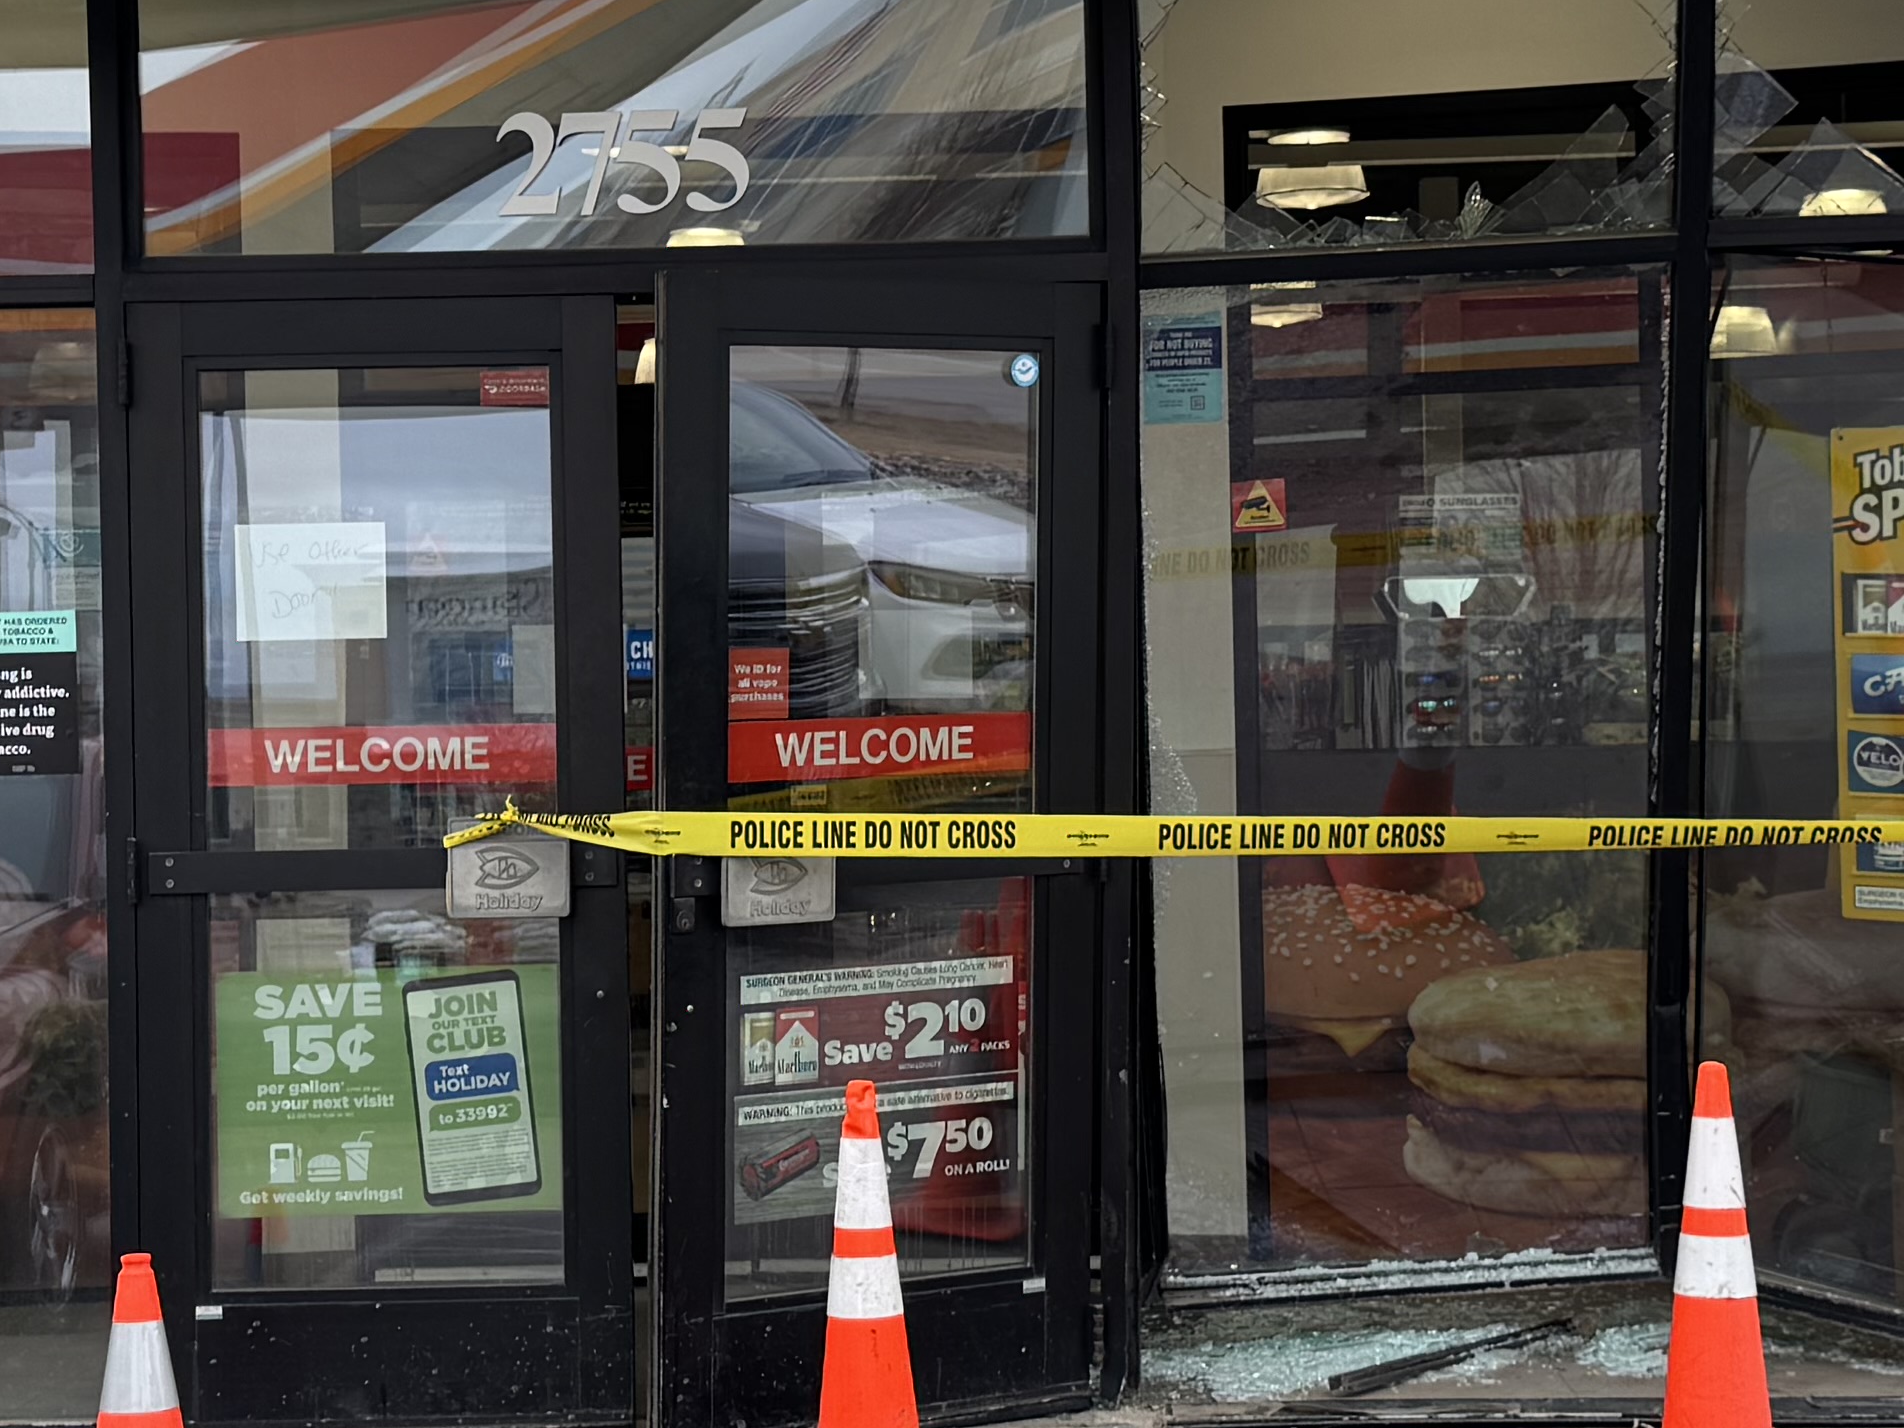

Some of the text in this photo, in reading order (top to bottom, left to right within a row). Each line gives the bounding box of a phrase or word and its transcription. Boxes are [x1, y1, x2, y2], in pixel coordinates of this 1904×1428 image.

[496, 107, 750, 217] 2755
[20, 666, 33, 680] is
[4, 684, 70, 699] addictive.
[18, 703, 31, 718] is
[32, 703, 56, 717] the
[22, 722, 54, 739] drug
[264, 735, 490, 774] WELCOME
[775, 725, 974, 768] WELCOME
[730, 820, 1016, 849] POLICE LINE DO NOT CROSS
[1158, 822, 1446, 850] POLICE LINE DO NOT CROSS
[1588, 825, 1883, 847] POLICE LINE DO NOT CROSS
[475, 892, 543, 912] Holiday
[749, 898, 811, 917] Holiday
[746, 974, 785, 988] SURGEON
[787, 972, 833, 985] GENERAL'S
[254, 983, 383, 1019] SAVE
[428, 990, 498, 1020] JOIN
[431, 1014, 497, 1031] OUR TEXT
[426, 1025, 507, 1054] CLUB
[949, 1044, 968, 1055] ANY
[981, 1041, 1010, 1052] PACKS
[263, 1023, 375, 1076] 15¢
[824, 1040, 893, 1066] Save
[439, 1064, 470, 1078] Text
[257, 1083, 285, 1097] per
[433, 1071, 511, 1094] HOLIDAY
[246, 1094, 394, 1113] on your next visit!
[744, 1105, 793, 1120] WARNING:
[815, 1101, 846, 1115] produc
[438, 1113, 454, 1125] to
[945, 1164, 963, 1176] ON
[965, 1163, 975, 1174] A
[239, 1187, 403, 1204] Get weekly savings!
